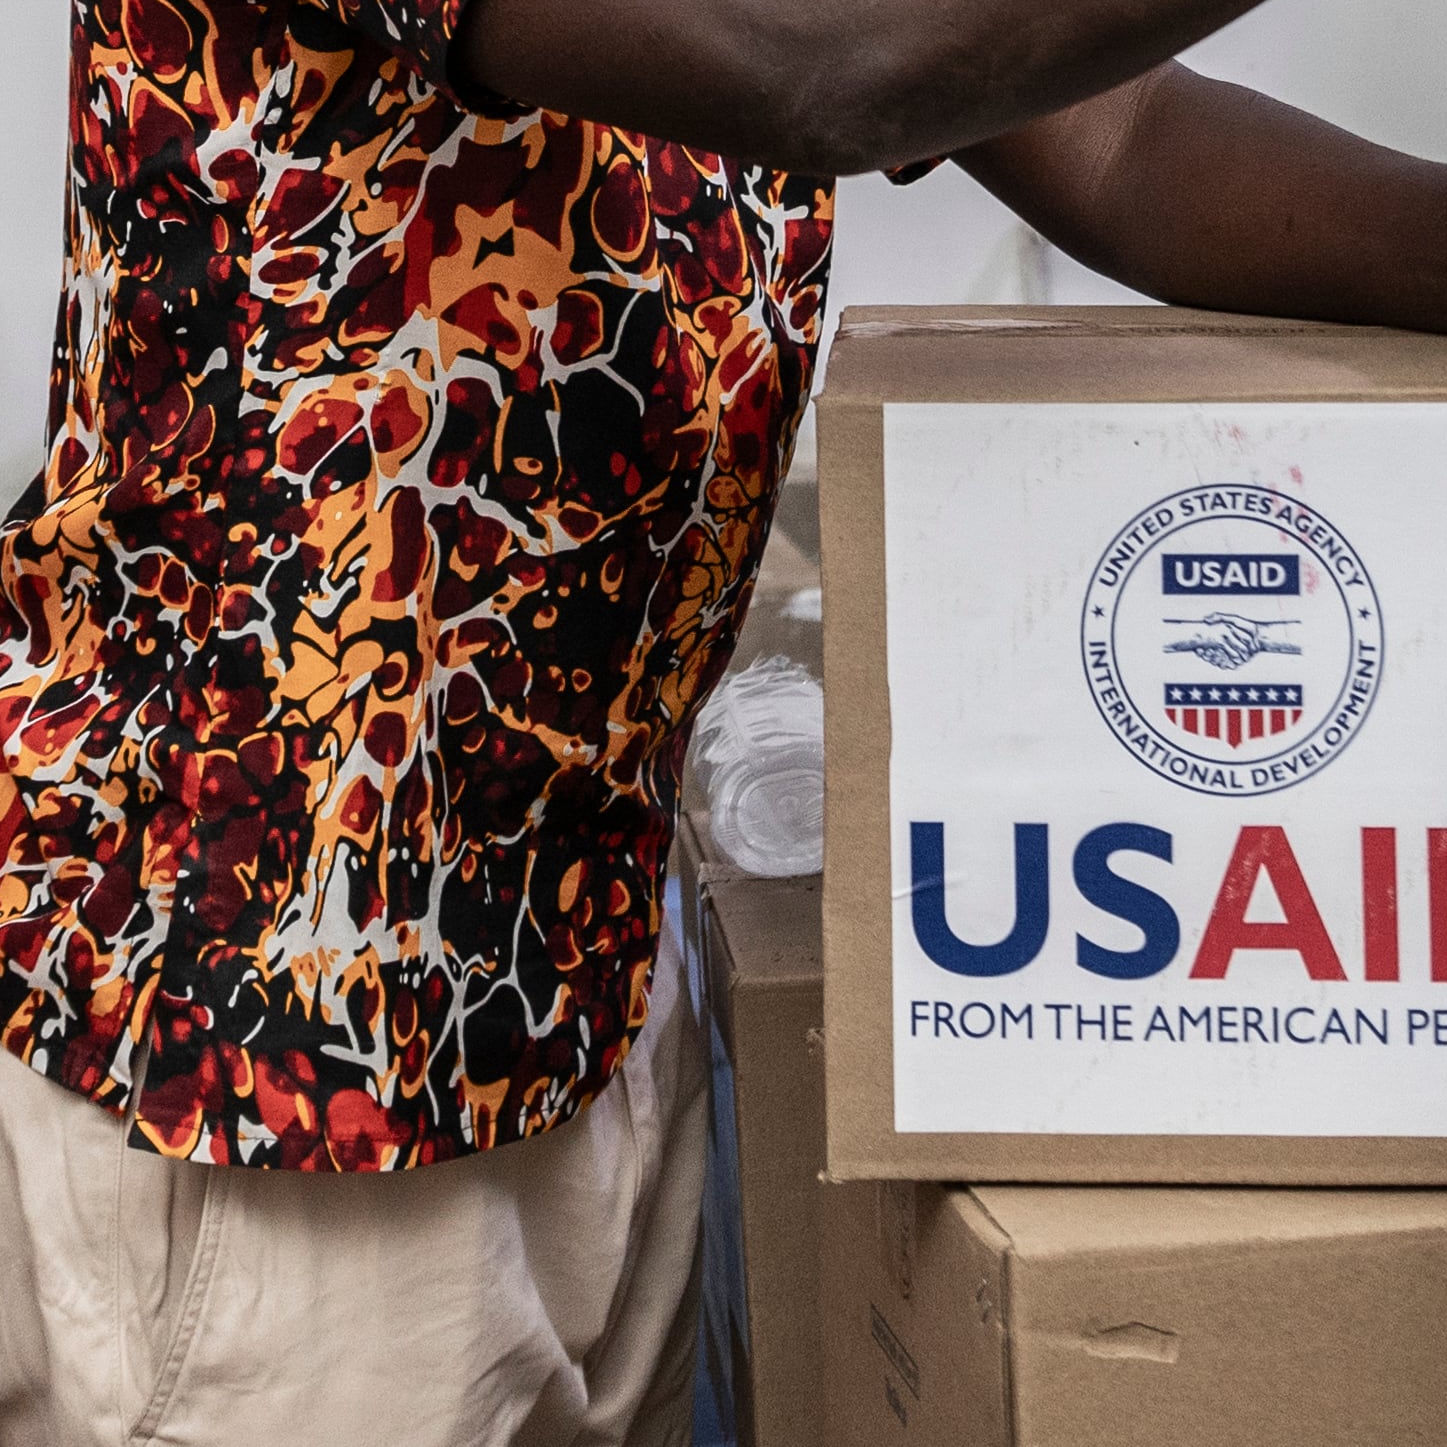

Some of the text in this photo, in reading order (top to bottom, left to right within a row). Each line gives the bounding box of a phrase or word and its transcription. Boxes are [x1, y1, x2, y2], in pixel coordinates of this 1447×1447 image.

[1099, 492, 1366, 590] UNITED STATES AGENCY
[1173, 560, 1288, 589] USAID
[1089, 640, 1377, 790] INTERNATIONAL DEVELOPMENT
[910, 999, 1034, 1042] FROM
[1053, 1003, 1134, 1042] THE
[1144, 1003, 1389, 1047] AMERICAN
